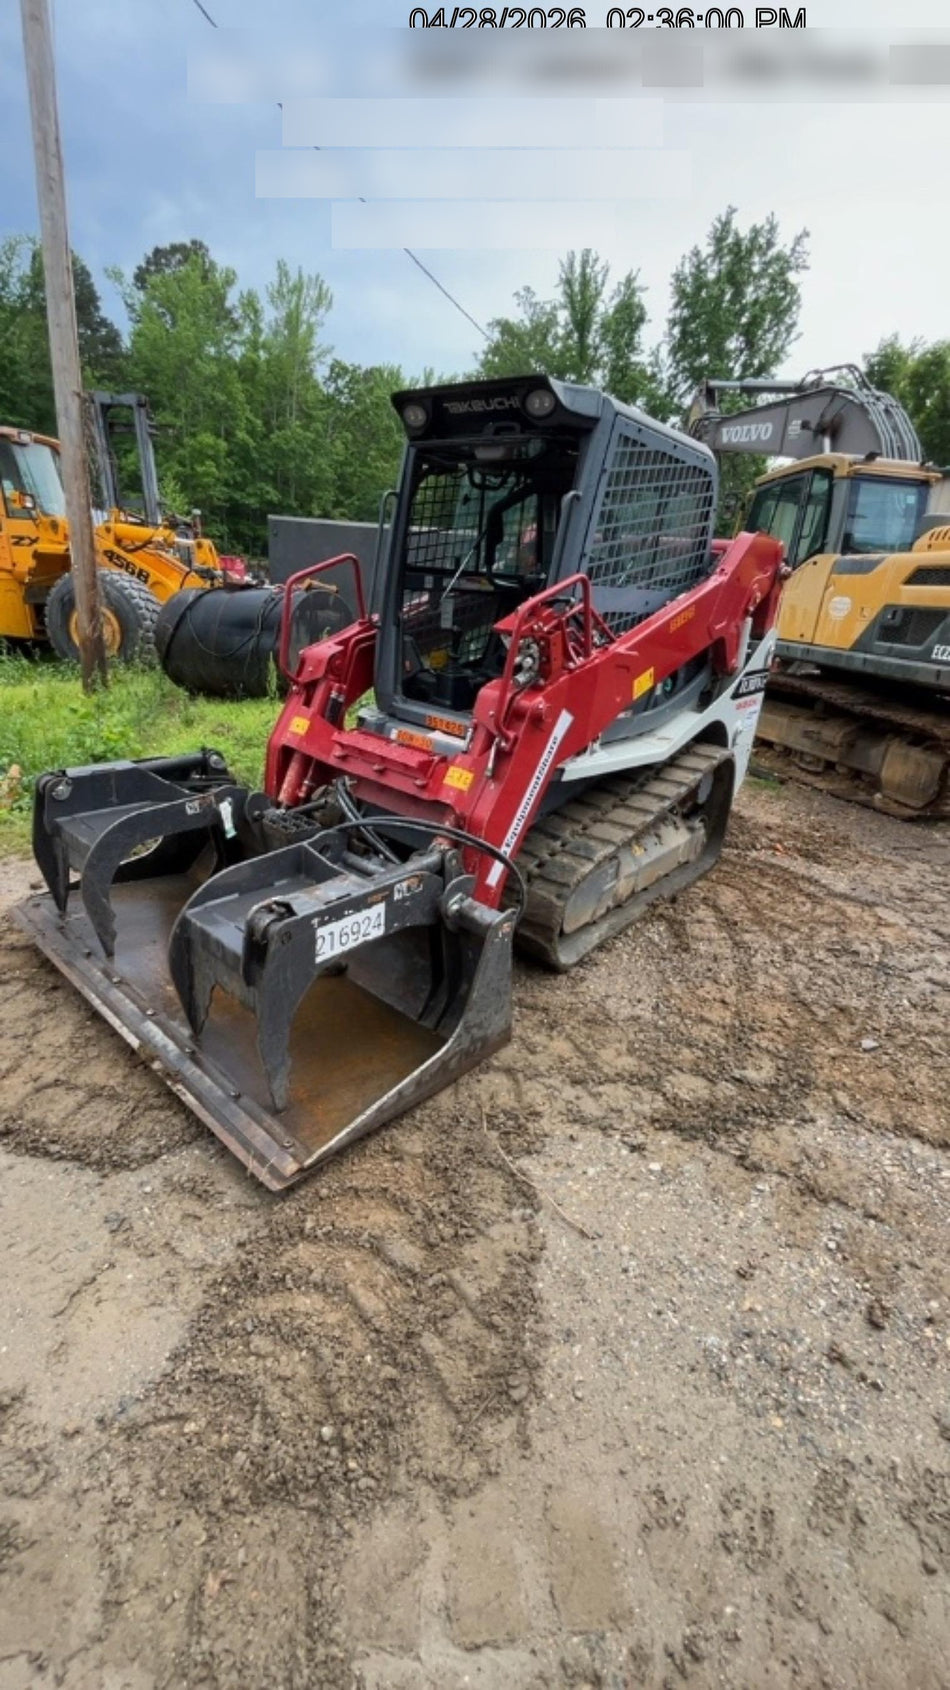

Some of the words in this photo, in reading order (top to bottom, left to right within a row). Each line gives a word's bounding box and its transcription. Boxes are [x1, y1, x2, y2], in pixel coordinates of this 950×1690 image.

[442, 396, 520, 413] TAKEUCHI
[721, 422, 773, 443] VOLVO
[315, 912, 383, 956] 216924
